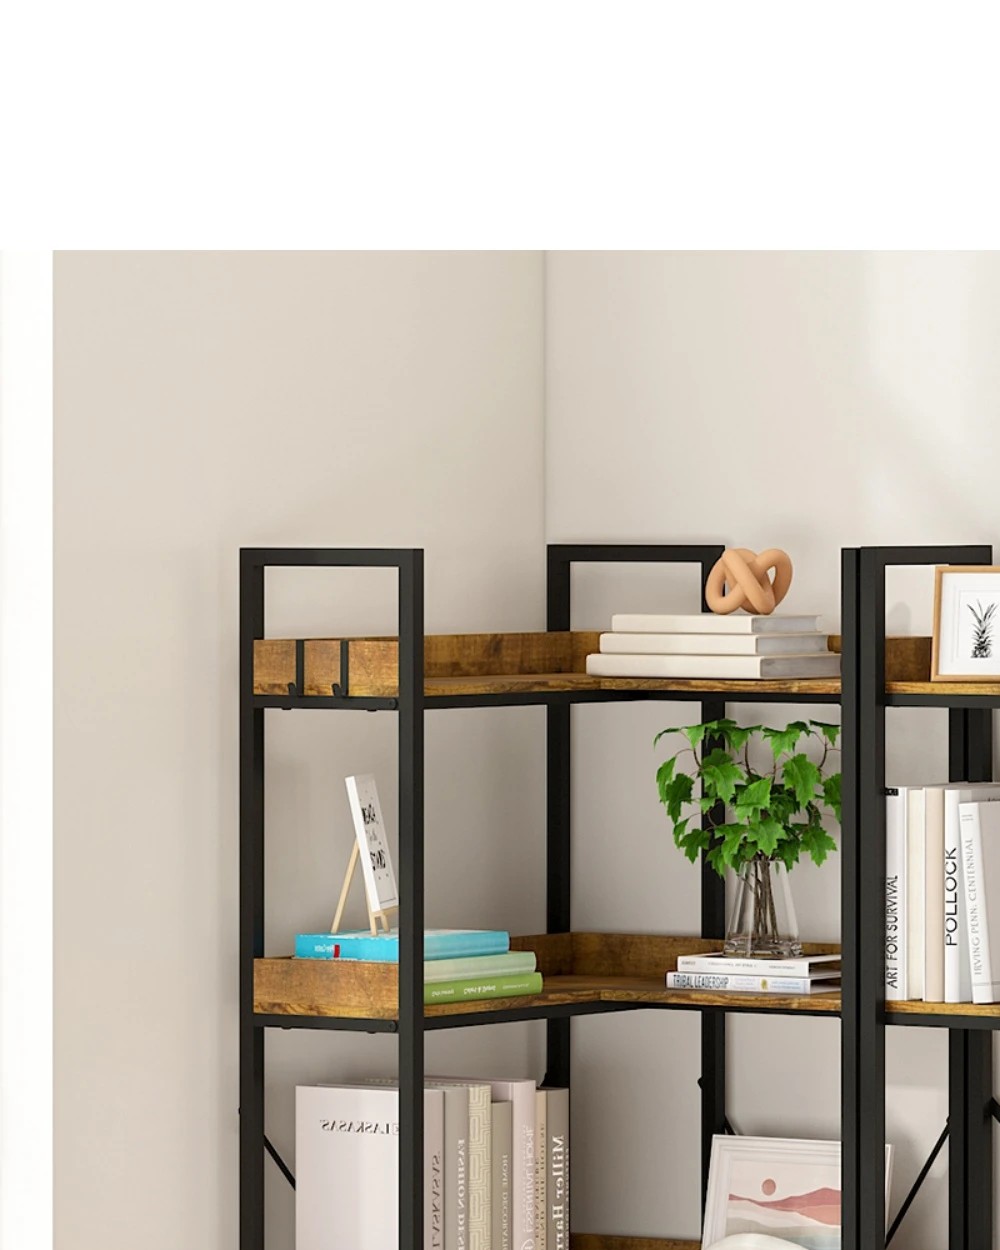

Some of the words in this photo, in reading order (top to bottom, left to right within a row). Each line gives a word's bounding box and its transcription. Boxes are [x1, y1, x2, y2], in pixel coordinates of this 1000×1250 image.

[964, 838, 977, 901] CENTENNIAL
[886, 875, 898, 931] SURVIVAL
[945, 847, 958, 946] POLLOCK
[886, 935, 898, 963] FOR
[673, 974, 694, 988] TRIBAL
[694, 974, 729, 989] LEADERSHIP
[886, 967, 899, 989] ART
